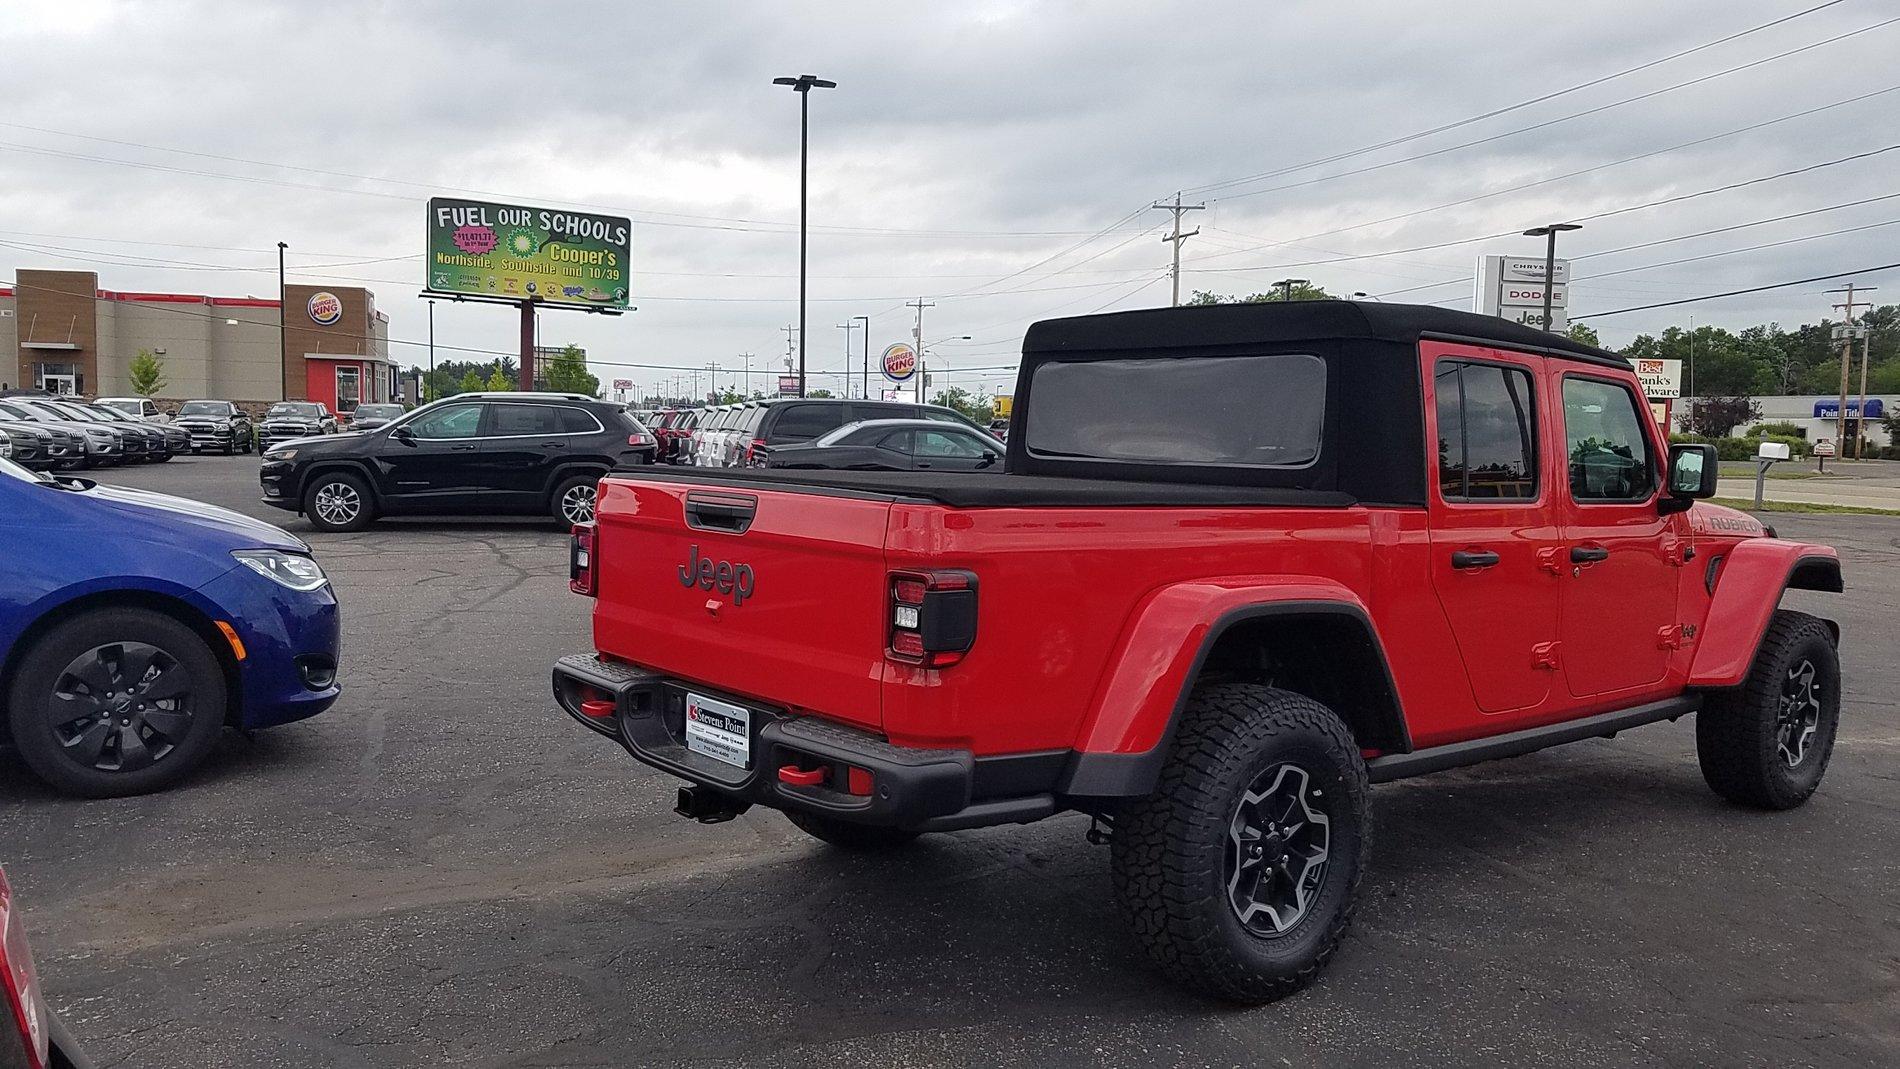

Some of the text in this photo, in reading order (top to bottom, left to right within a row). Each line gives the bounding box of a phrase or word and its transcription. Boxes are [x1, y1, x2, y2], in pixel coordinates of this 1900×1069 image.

[437, 207, 627, 246] FUEL OUR SCHOOLS
[550, 244, 617, 267] Cooper's
[437, 252, 620, 281] Northside, Southside and 10/39
[1512, 263, 1563, 271] CHRYSR
[1509, 290, 1562, 301] DODE
[312, 299, 337, 309] BURGER
[313, 304, 338, 316] KING
[886, 351, 913, 364] BURGER
[887, 358, 915, 373] KING
[1640, 362, 1663, 374] Best
[1639, 375, 1671, 386] ank's
[1643, 386, 1679, 396] dware
[1820, 408, 1838, 418] Poin
[678, 544, 754, 607] Jeep
[697, 708, 724, 729] Stevens
[724, 716, 746, 736] Point
